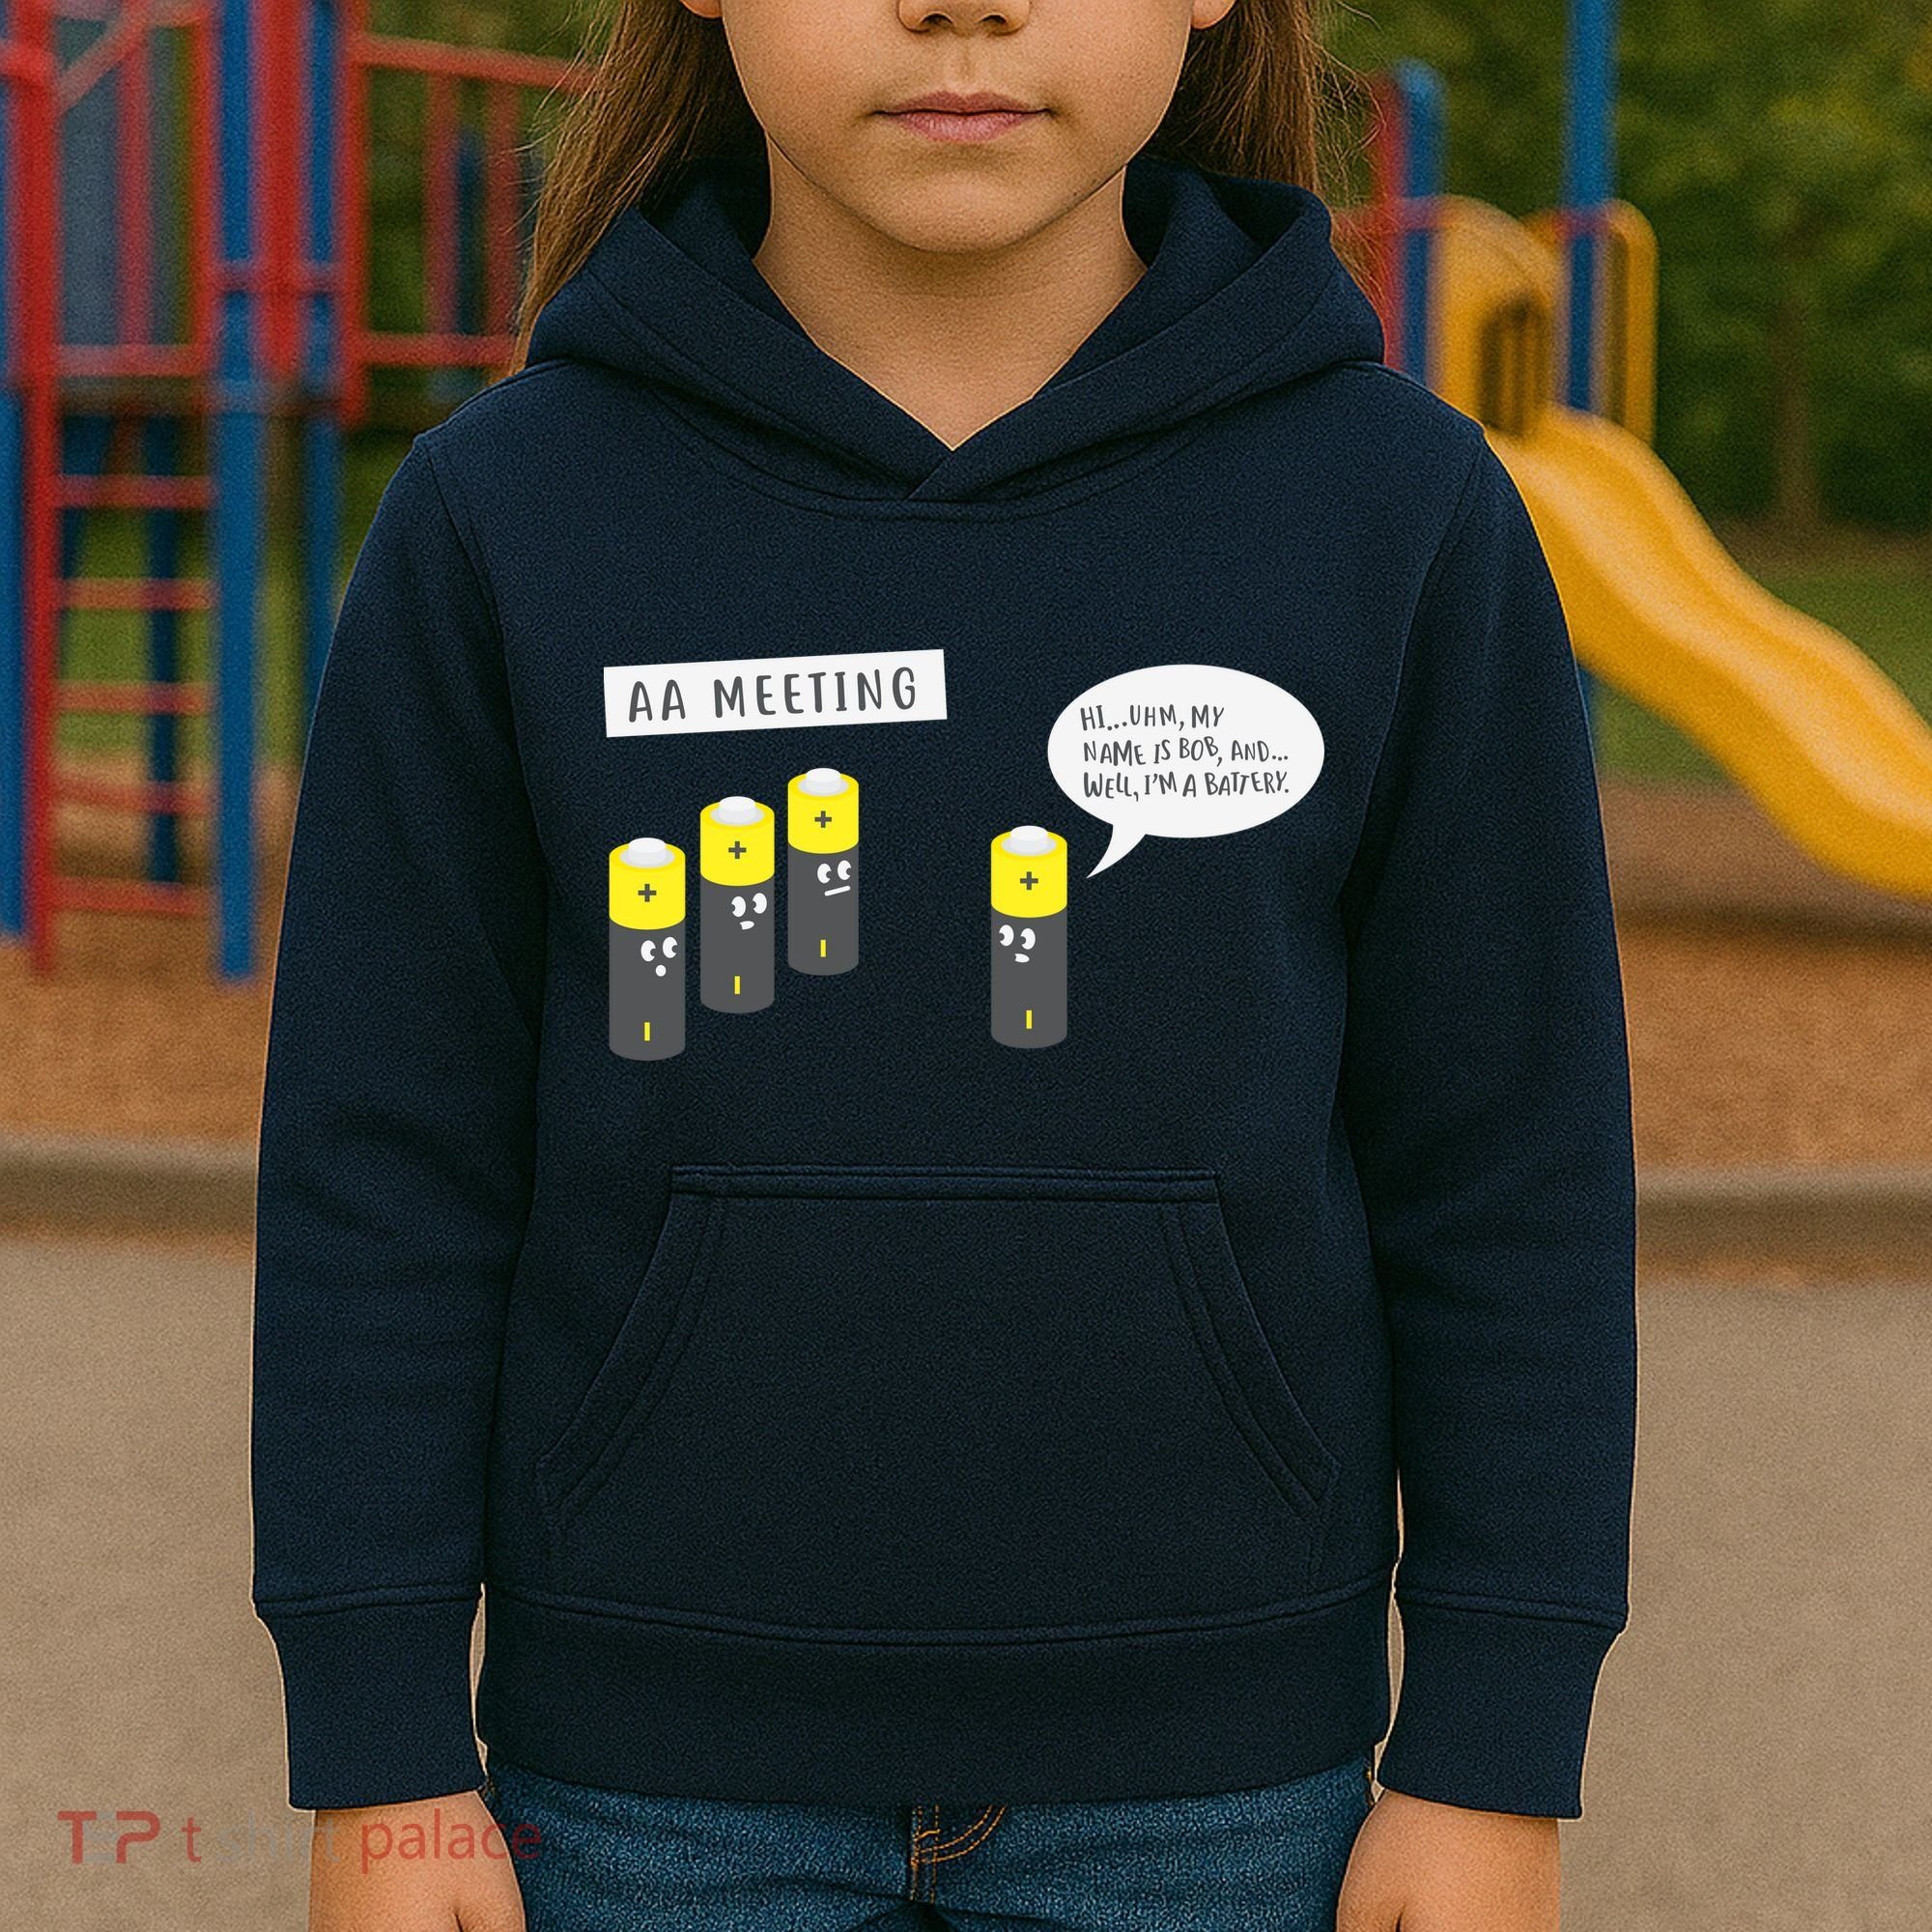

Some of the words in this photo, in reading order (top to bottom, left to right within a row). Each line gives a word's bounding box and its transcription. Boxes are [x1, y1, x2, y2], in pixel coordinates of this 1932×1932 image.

[629, 679, 686, 723] AA
[713, 667, 916, 719] MEETING
[1191, 704, 1225, 728] MY
[1083, 739, 1147, 767] NAME
[1152, 739, 1171, 764] IS
[1179, 736, 1223, 767] BOB,
[1231, 739, 1289, 762] AND...
[1083, 772, 1139, 803] WELL,
[1181, 773, 1197, 798] A
[1204, 770, 1290, 797] BATTERY.
